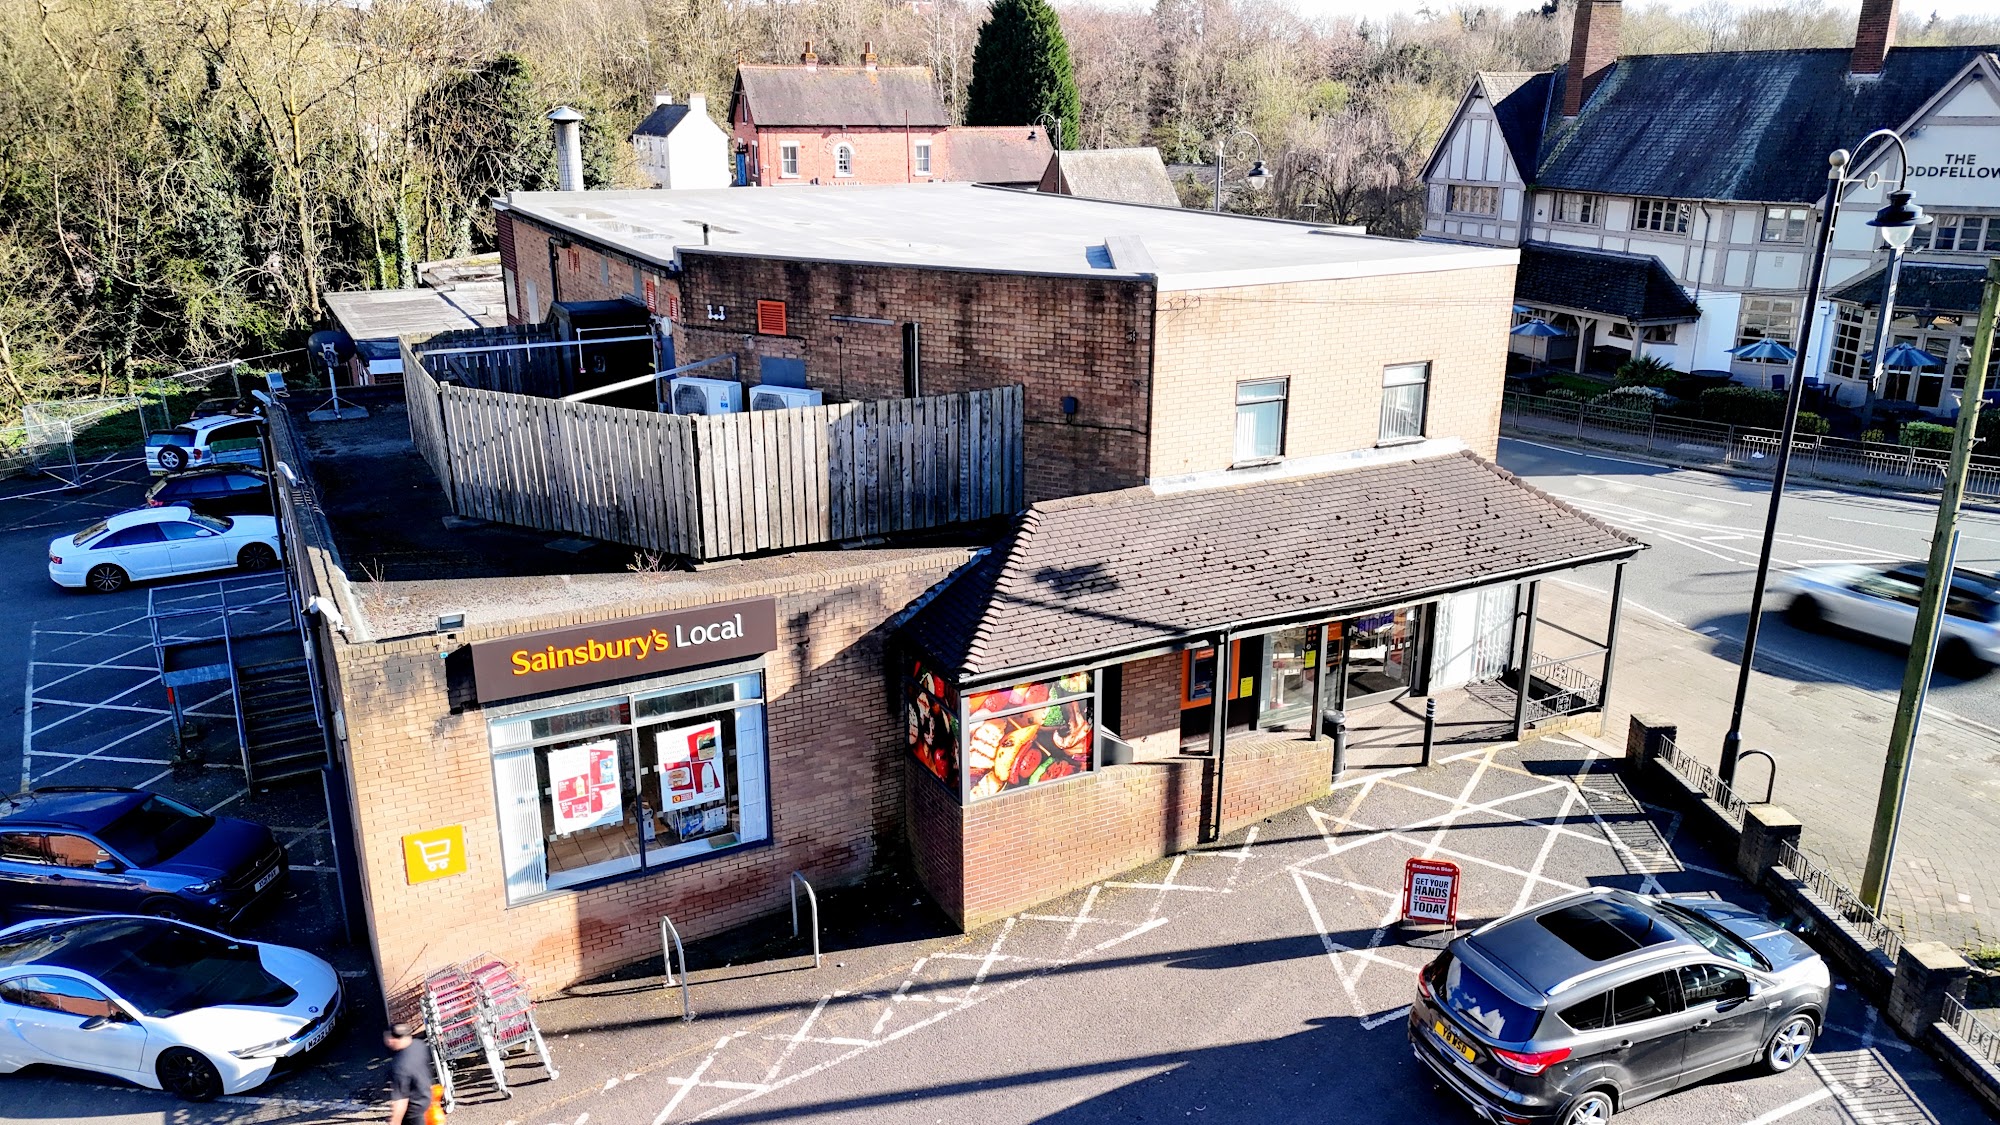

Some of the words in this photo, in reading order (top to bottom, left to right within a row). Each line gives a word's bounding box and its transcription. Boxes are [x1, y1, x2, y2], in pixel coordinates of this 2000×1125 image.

[1945, 154, 1976, 165] THE
[511, 629, 669, 676] Sainsbury's
[675, 613, 744, 648] Local
[1415, 877, 1429, 885] GET
[1430, 879, 1449, 888] YOUR
[1414, 886, 1448, 898] HANDS
[1413, 901, 1446, 914] TODAY
